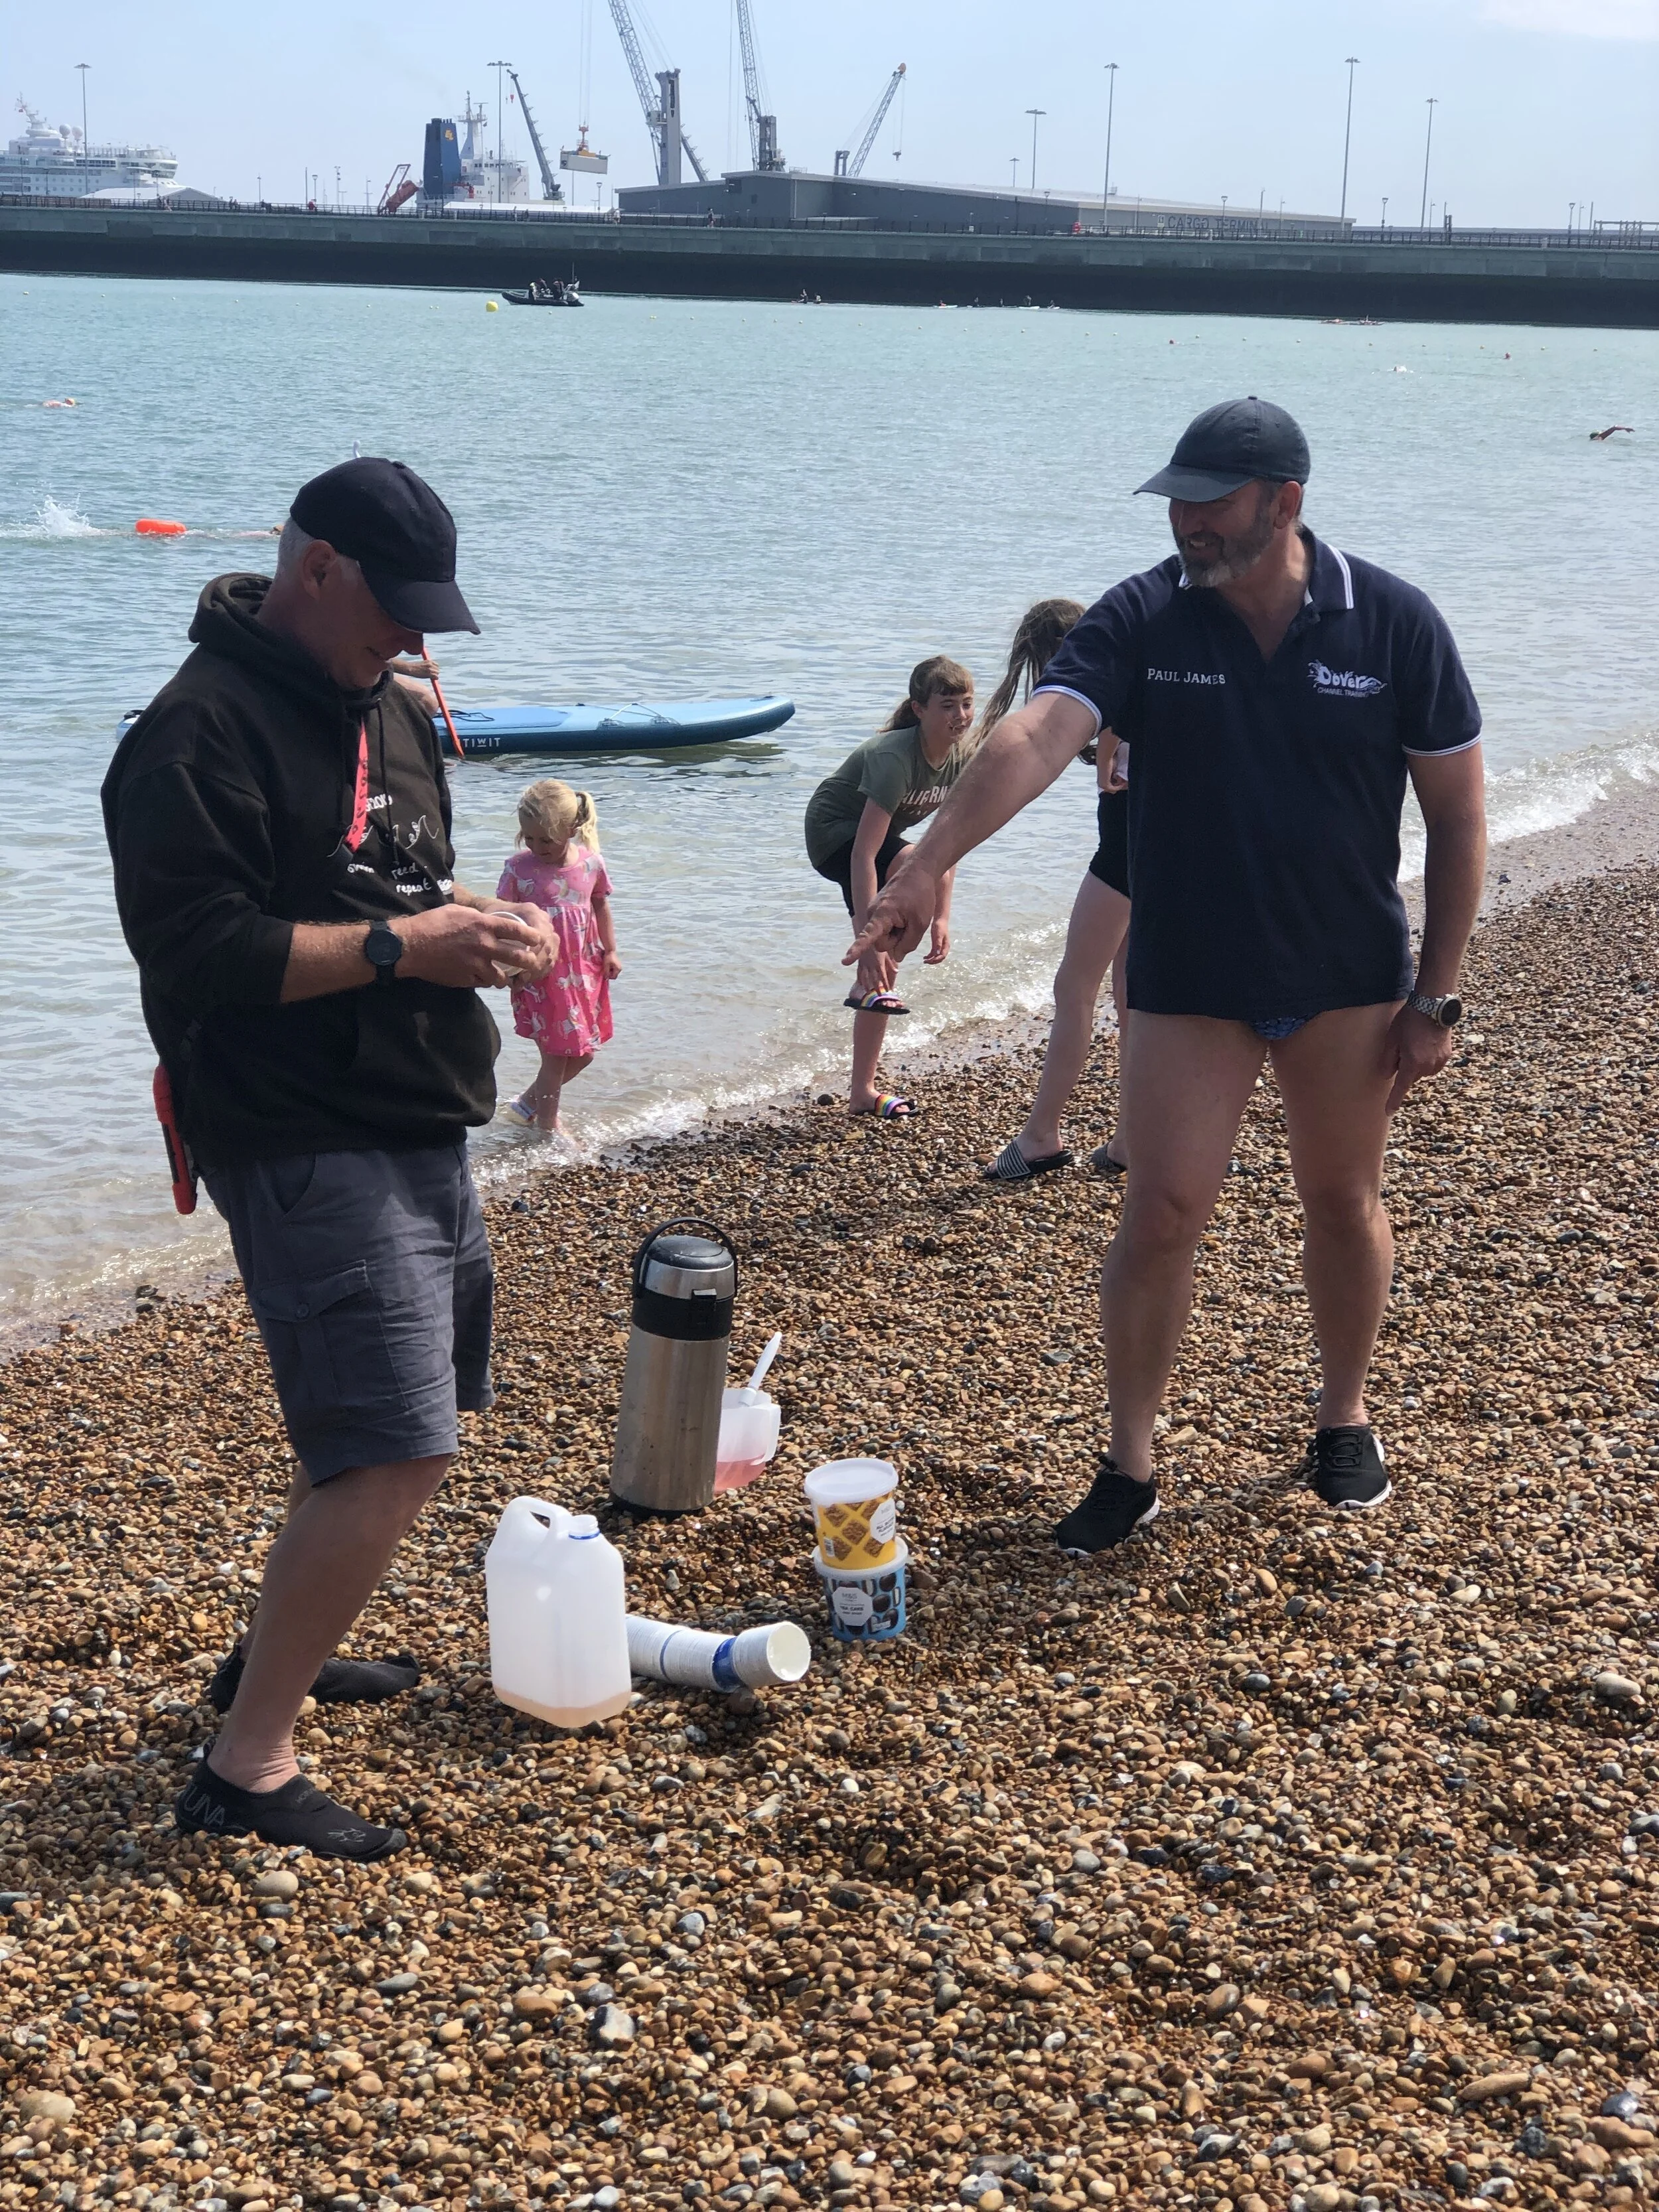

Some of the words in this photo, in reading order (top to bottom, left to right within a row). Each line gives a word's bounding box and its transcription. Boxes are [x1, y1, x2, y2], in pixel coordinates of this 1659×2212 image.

[1168, 216, 1209, 229] CARGO
[1147, 668, 1180, 682] PAUL
[1183, 672, 1226, 685] JAMES
[396, 877, 431, 896] repeat
